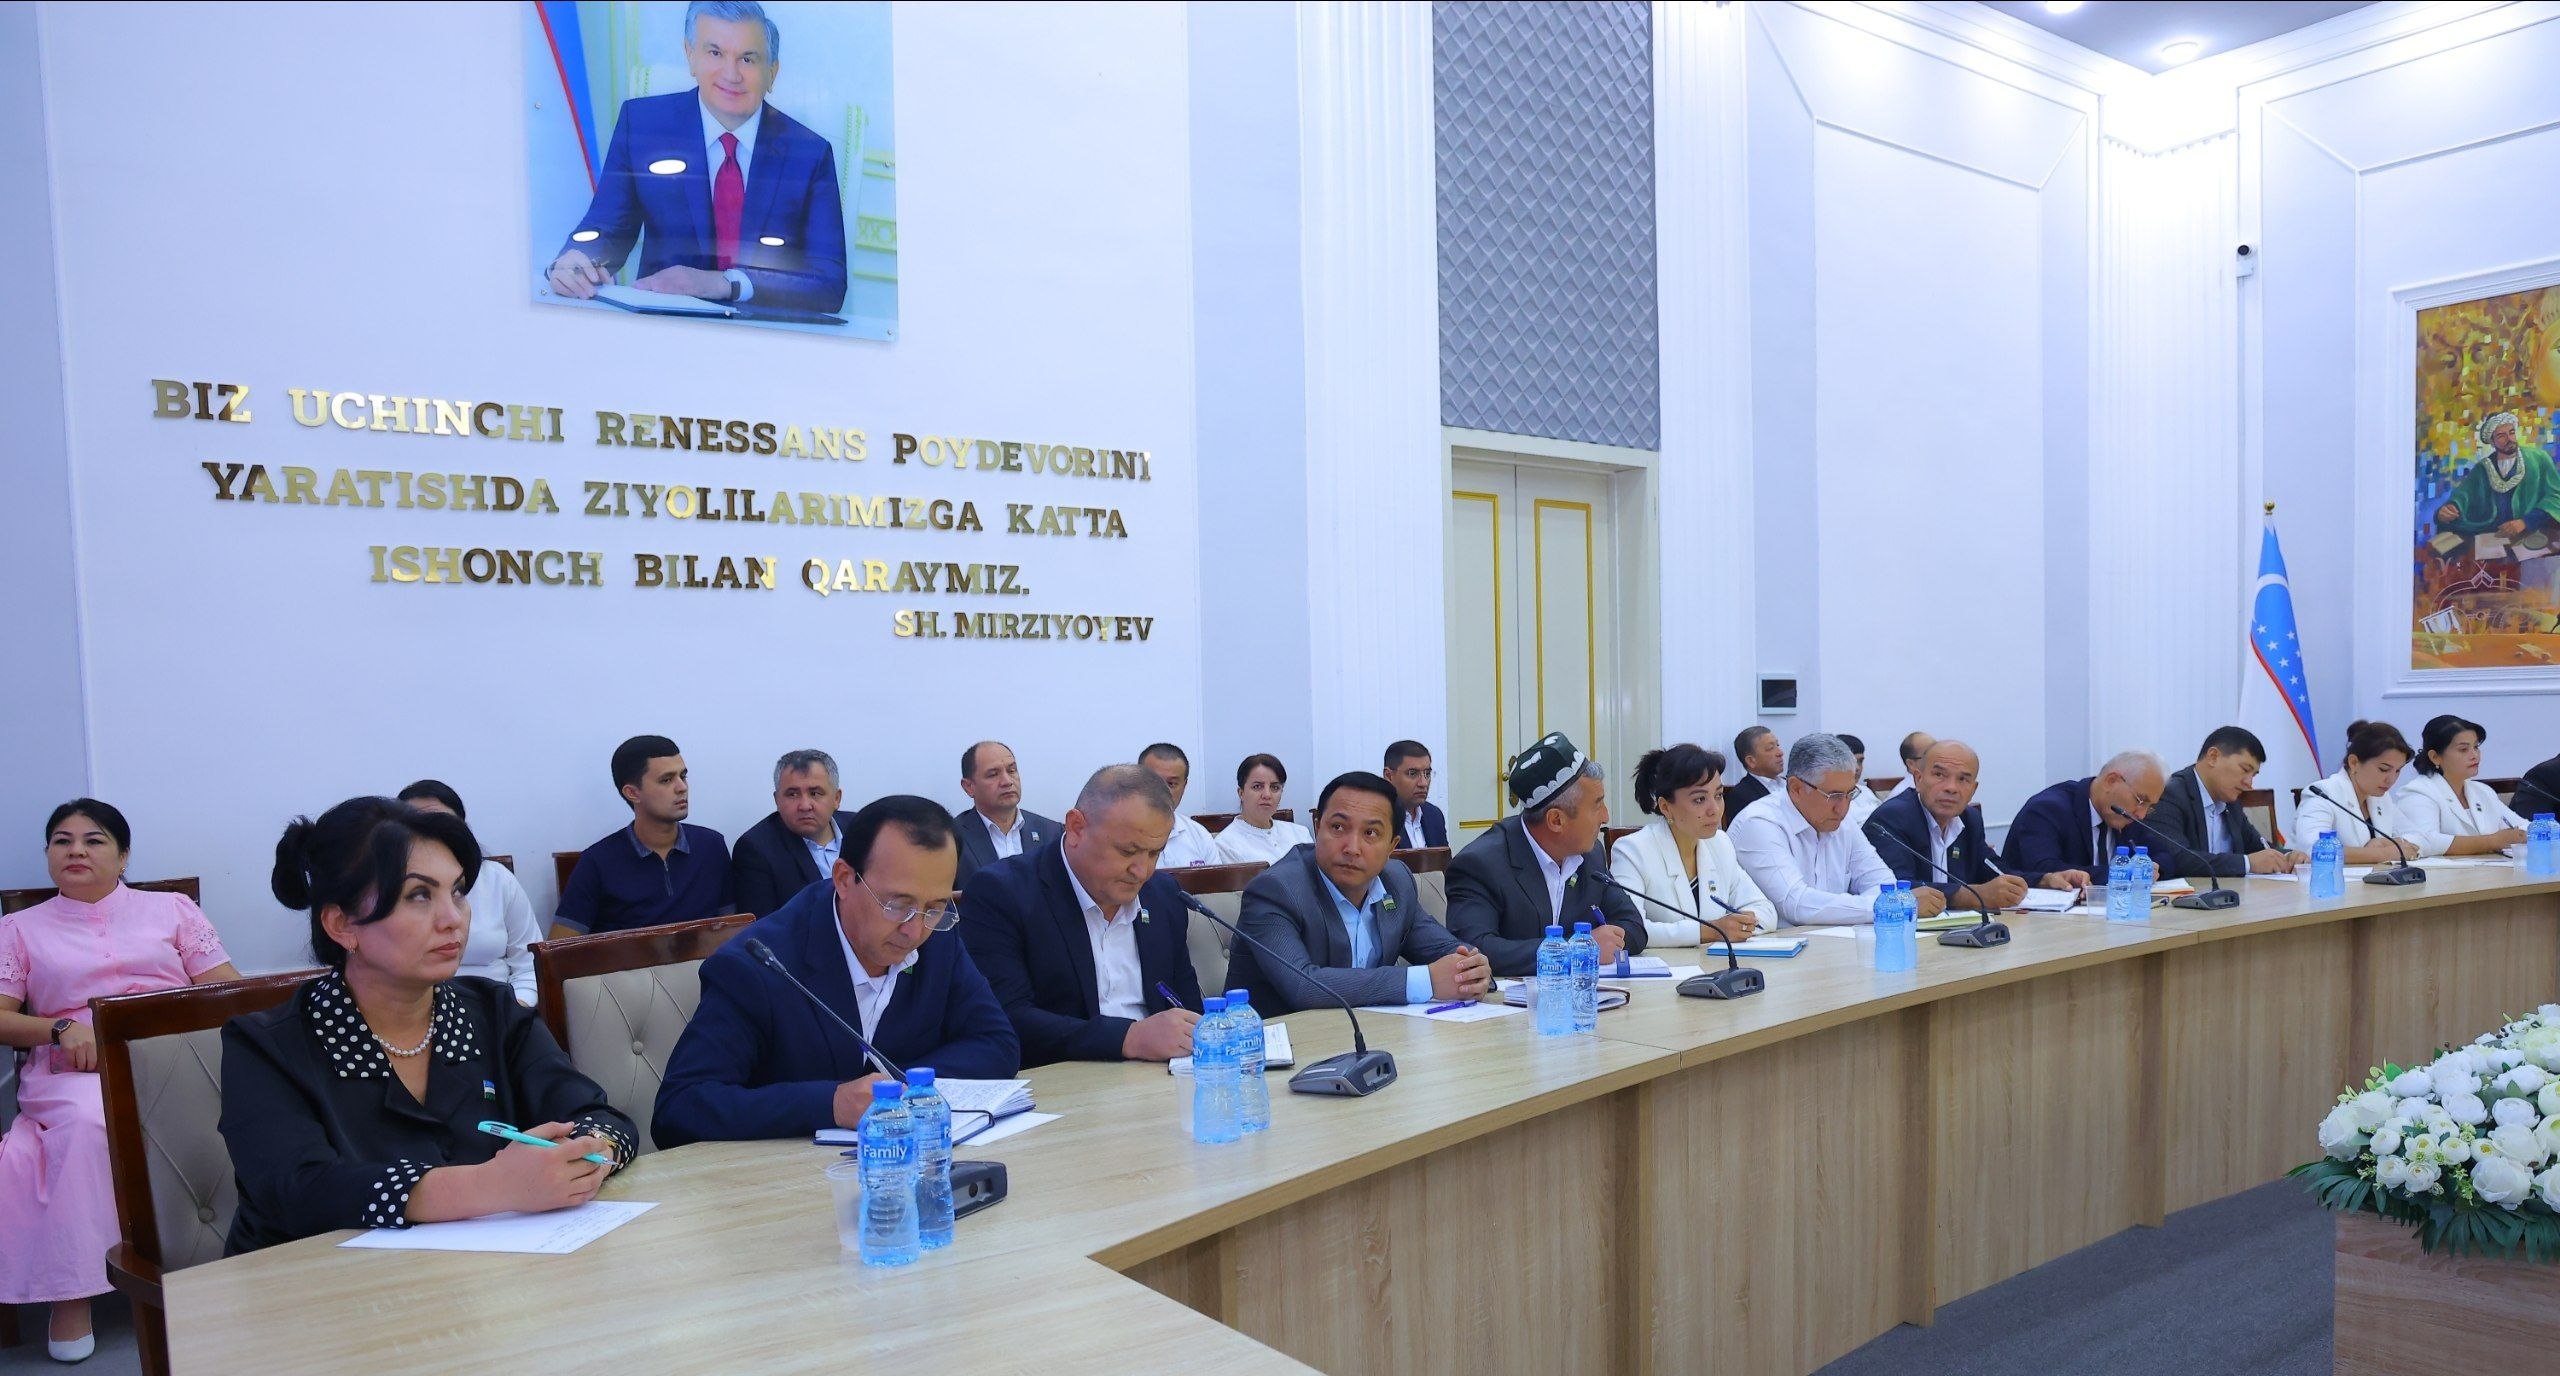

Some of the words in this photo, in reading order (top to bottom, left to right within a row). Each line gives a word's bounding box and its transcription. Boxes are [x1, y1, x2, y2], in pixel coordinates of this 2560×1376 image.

[152, 379, 253, 424] BIZ
[288, 387, 565, 443] UCHINCHI
[596, 410, 868, 463] RENESSANS
[893, 432, 1152, 482] POYDEVORINI
[202, 460, 560, 514] YARATISHDA
[583, 480, 984, 532] ZIYOLILARIMIZGA
[1007, 502, 1128, 539] KATTA
[369, 545, 604, 588] ISHONCH
[634, 553, 779, 591] BILAN
[801, 556, 1030, 598] QARAYMIZ.
[893, 608, 948, 640] SH.
[954, 611, 1154, 643] MIRZIYOYEV
[863, 1144, 908, 1161] Family
